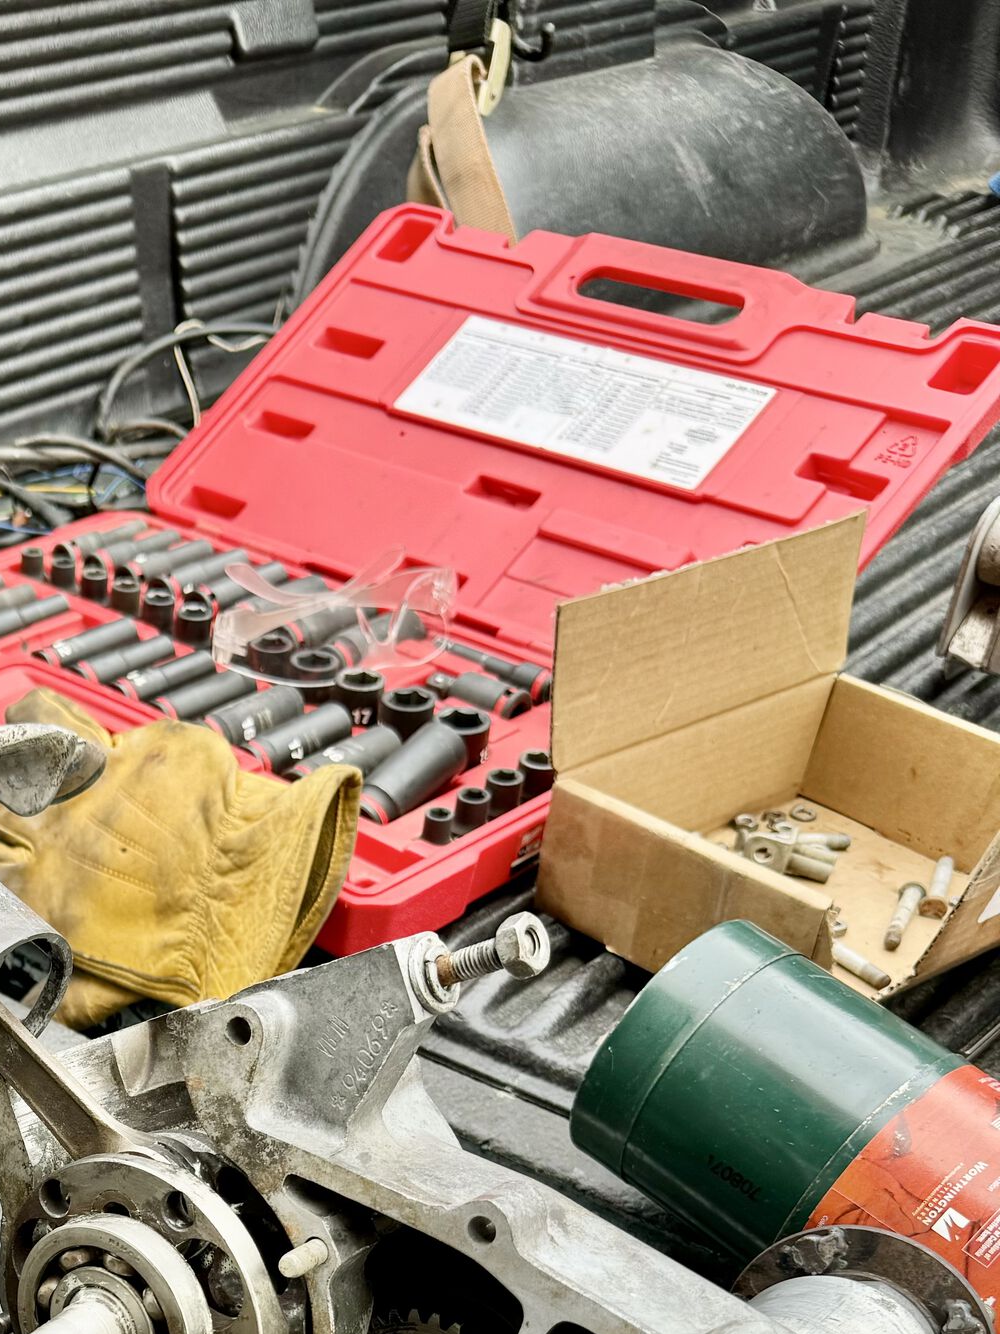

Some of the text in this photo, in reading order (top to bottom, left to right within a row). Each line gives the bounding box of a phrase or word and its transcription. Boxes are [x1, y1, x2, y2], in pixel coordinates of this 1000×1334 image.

[352, 708, 372, 725] 17
[916, 1182, 953, 1220] CYLINDERS
[922, 1161, 988, 1226] WORTHINGTON
